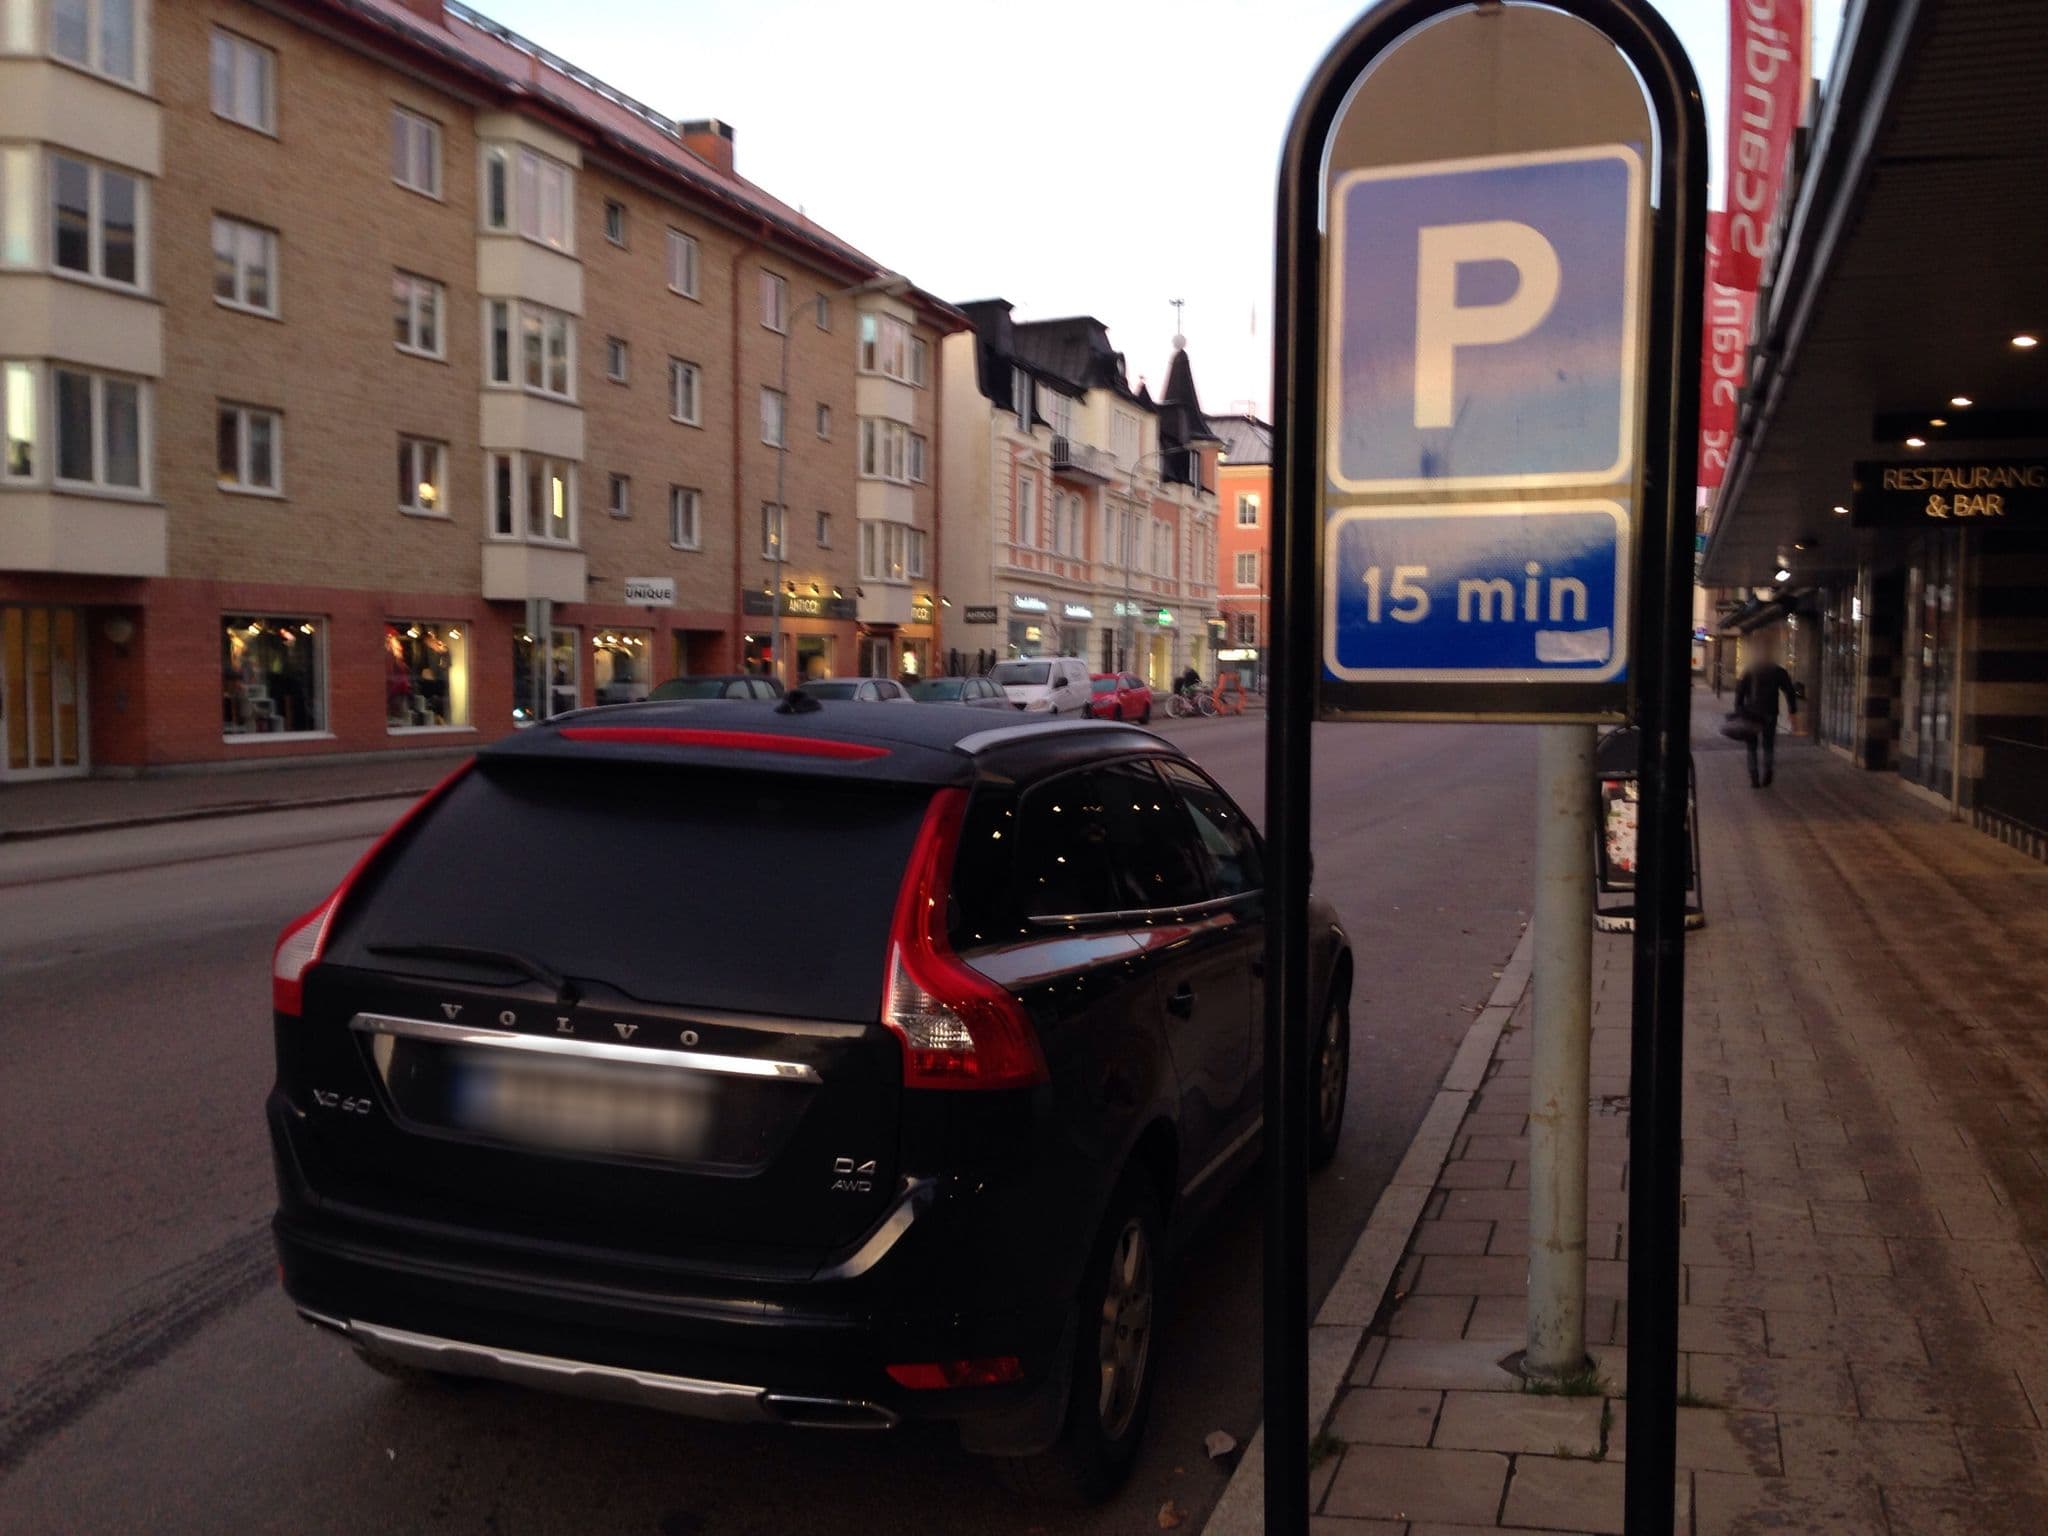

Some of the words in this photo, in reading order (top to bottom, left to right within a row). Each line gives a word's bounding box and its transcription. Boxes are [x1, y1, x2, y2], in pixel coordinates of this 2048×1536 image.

[1414, 220, 1562, 428] P
[1883, 466, 2047, 490] RESTAURANG
[1925, 494, 1951, 519] &
[1953, 494, 2005, 517] BAR
[625, 588, 672, 600] UNIQUE
[1362, 564, 1432, 624] 15
[1456, 560, 1588, 622] min
[441, 1002, 699, 1046] VOLVO
[833, 1157, 876, 1174] D4
[831, 1179, 871, 1192] AWD
